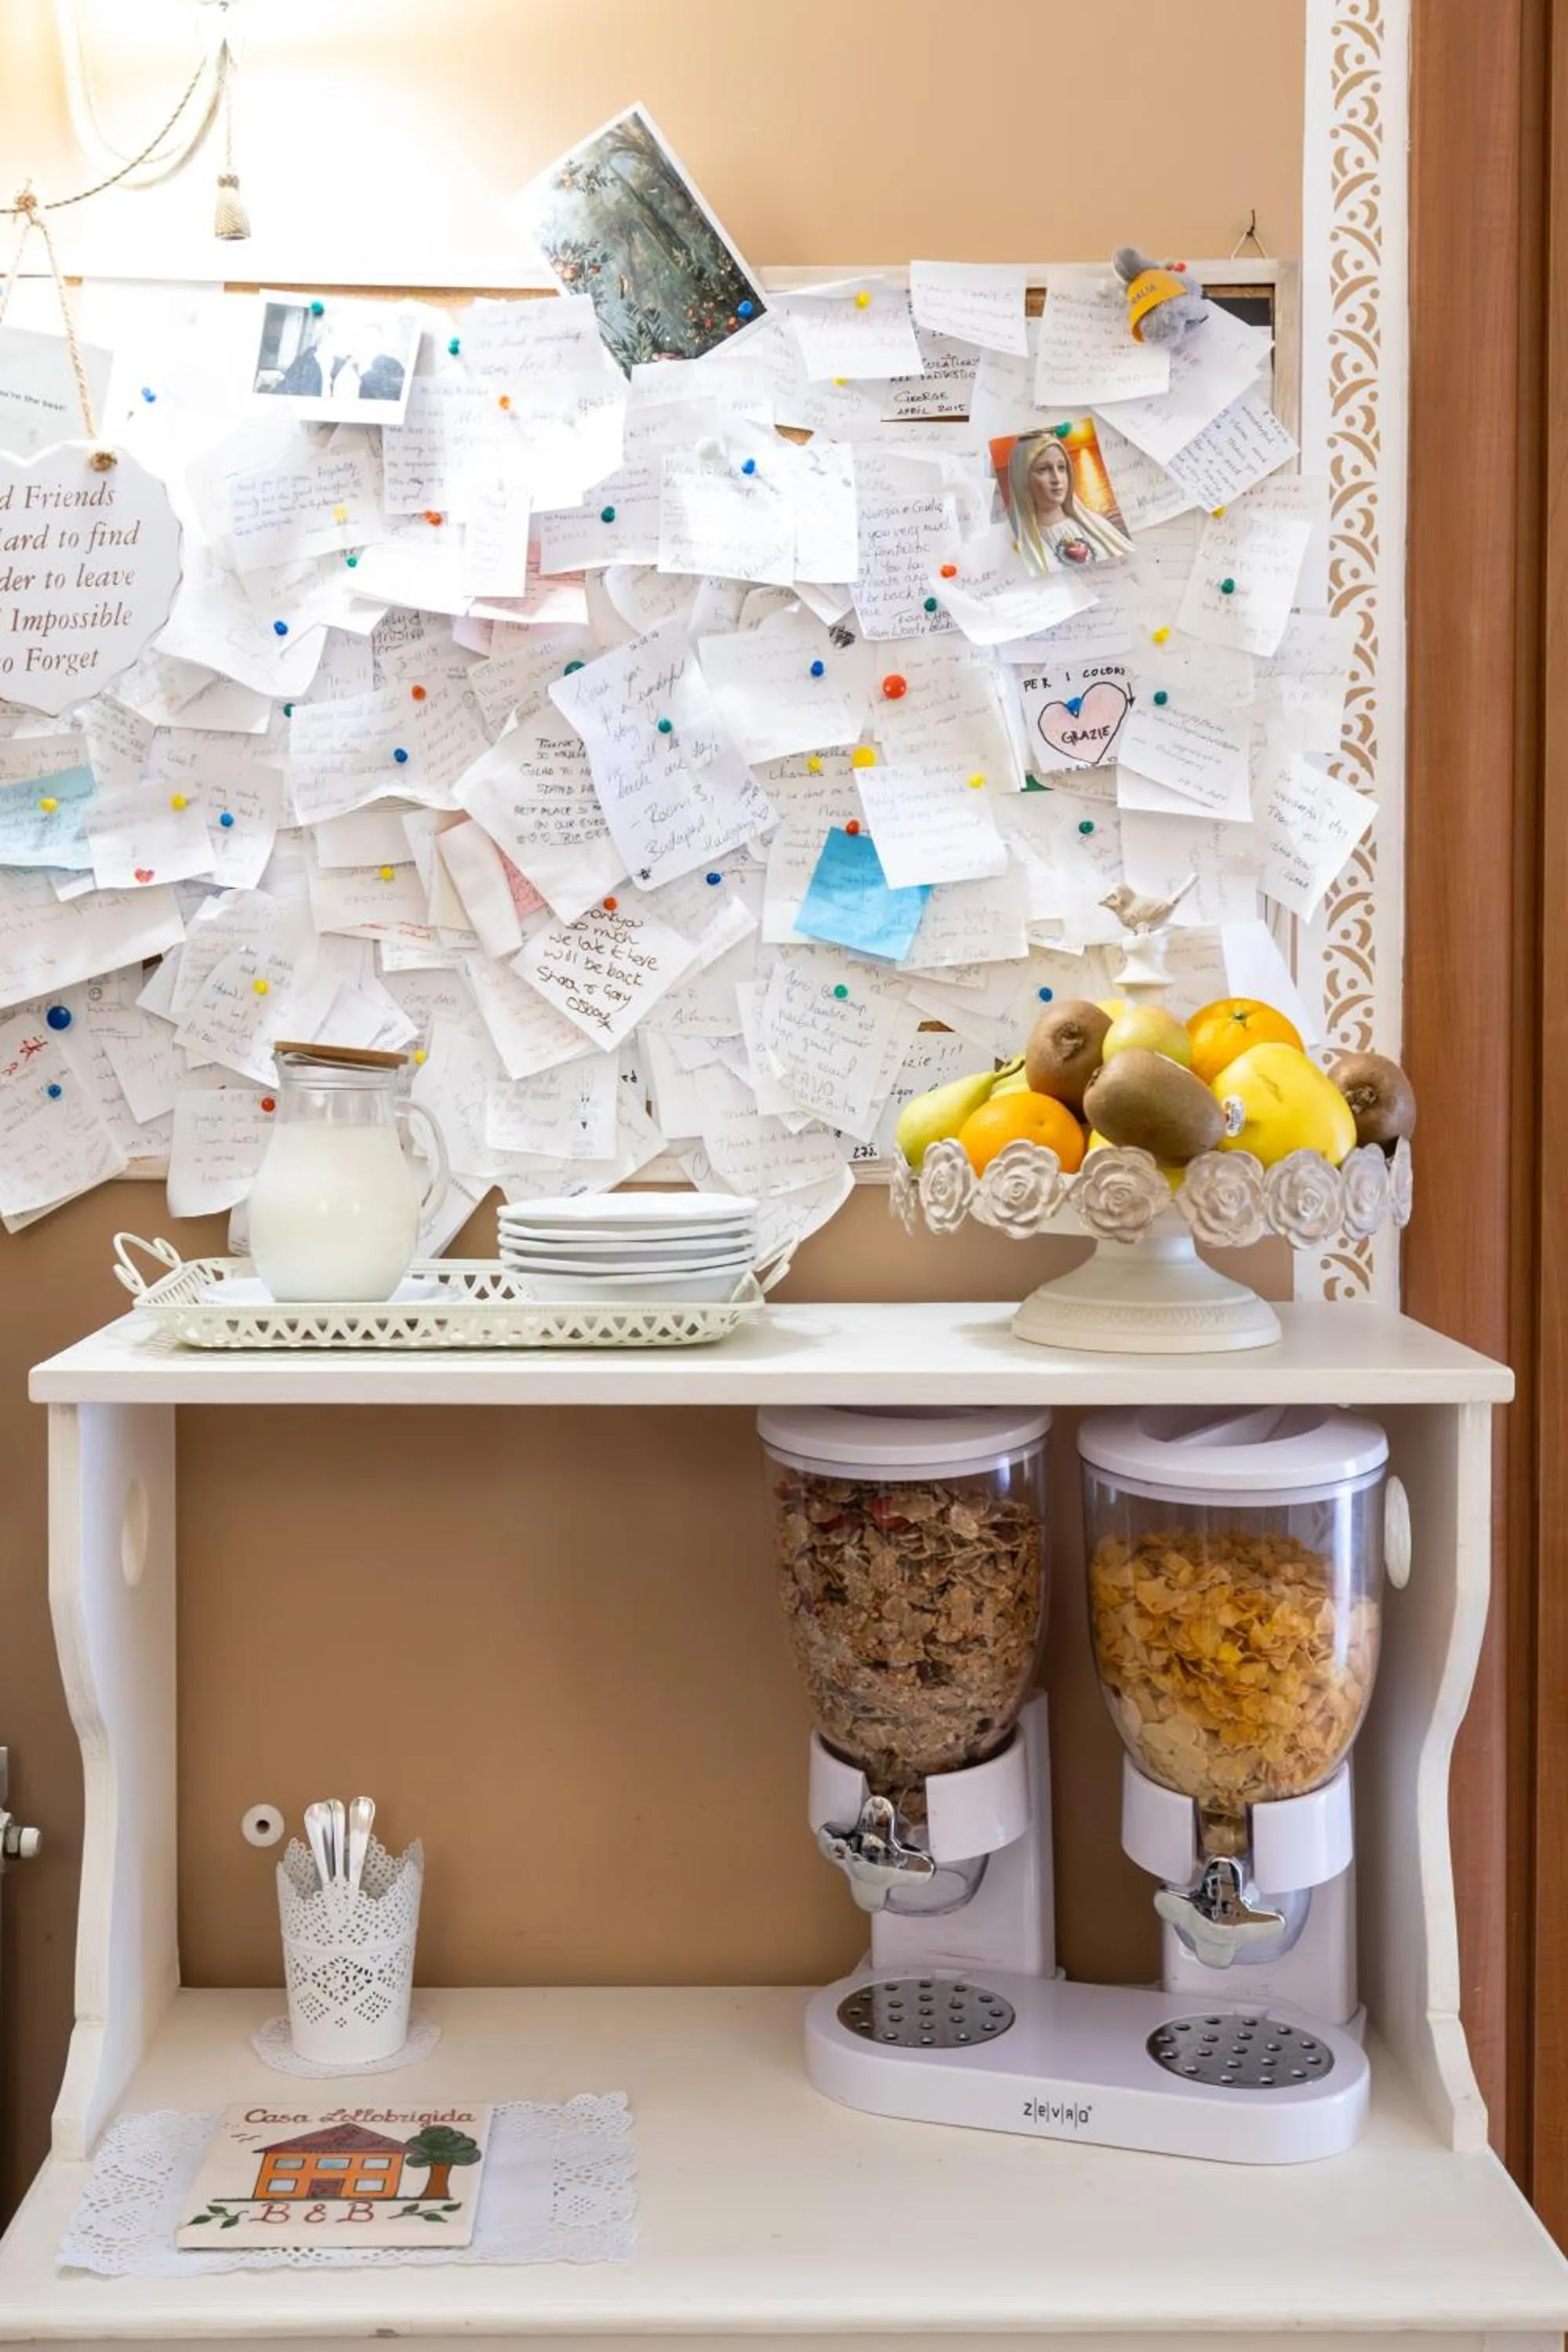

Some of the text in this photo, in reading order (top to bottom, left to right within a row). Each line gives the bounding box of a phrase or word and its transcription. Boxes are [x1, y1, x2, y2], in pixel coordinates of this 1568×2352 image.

[24, 481, 115, 510] Friends
[0, 519, 141, 555] ard to find
[45, 570, 66, 590] to
[75, 562, 136, 589] leave
[10, 601, 132, 637] Impossible
[24, 646, 100, 676] Forget
[1022, 666, 1126, 693] PER I COLORI
[1061, 725, 1111, 746] GRAZIE
[539, 805, 572, 817] PLACE
[548, 931, 573, 947] we
[593, 926, 640, 946] much
[543, 949, 644, 988] will be back
[602, 983, 633, 1013] Gary
[244, 2107, 477, 2128] Casa Lollobrigida
[248, 2200, 375, 2224] B & B
